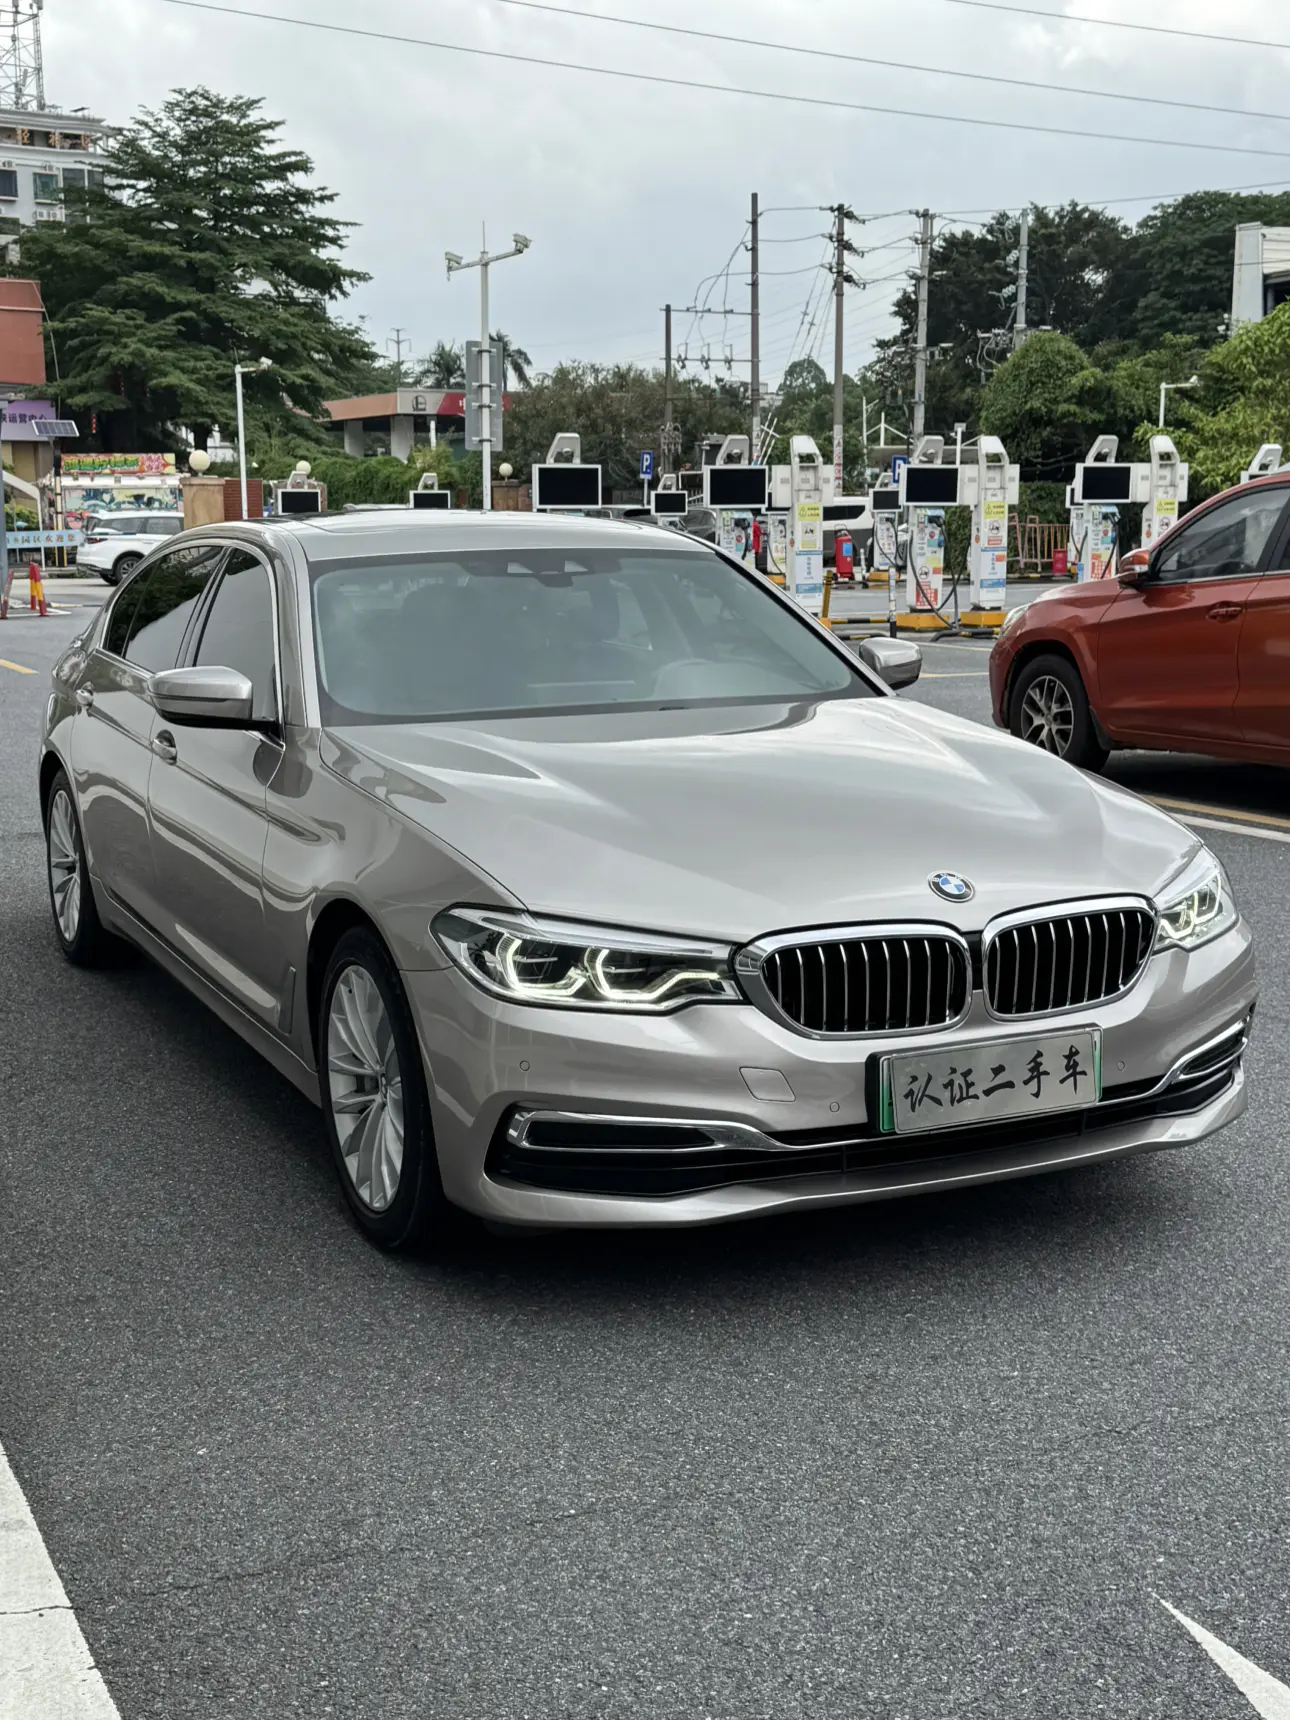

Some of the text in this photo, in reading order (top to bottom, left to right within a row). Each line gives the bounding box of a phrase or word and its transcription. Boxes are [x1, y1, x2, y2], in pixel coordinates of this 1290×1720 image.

[903, 1044, 1088, 1113] 认证二手车
